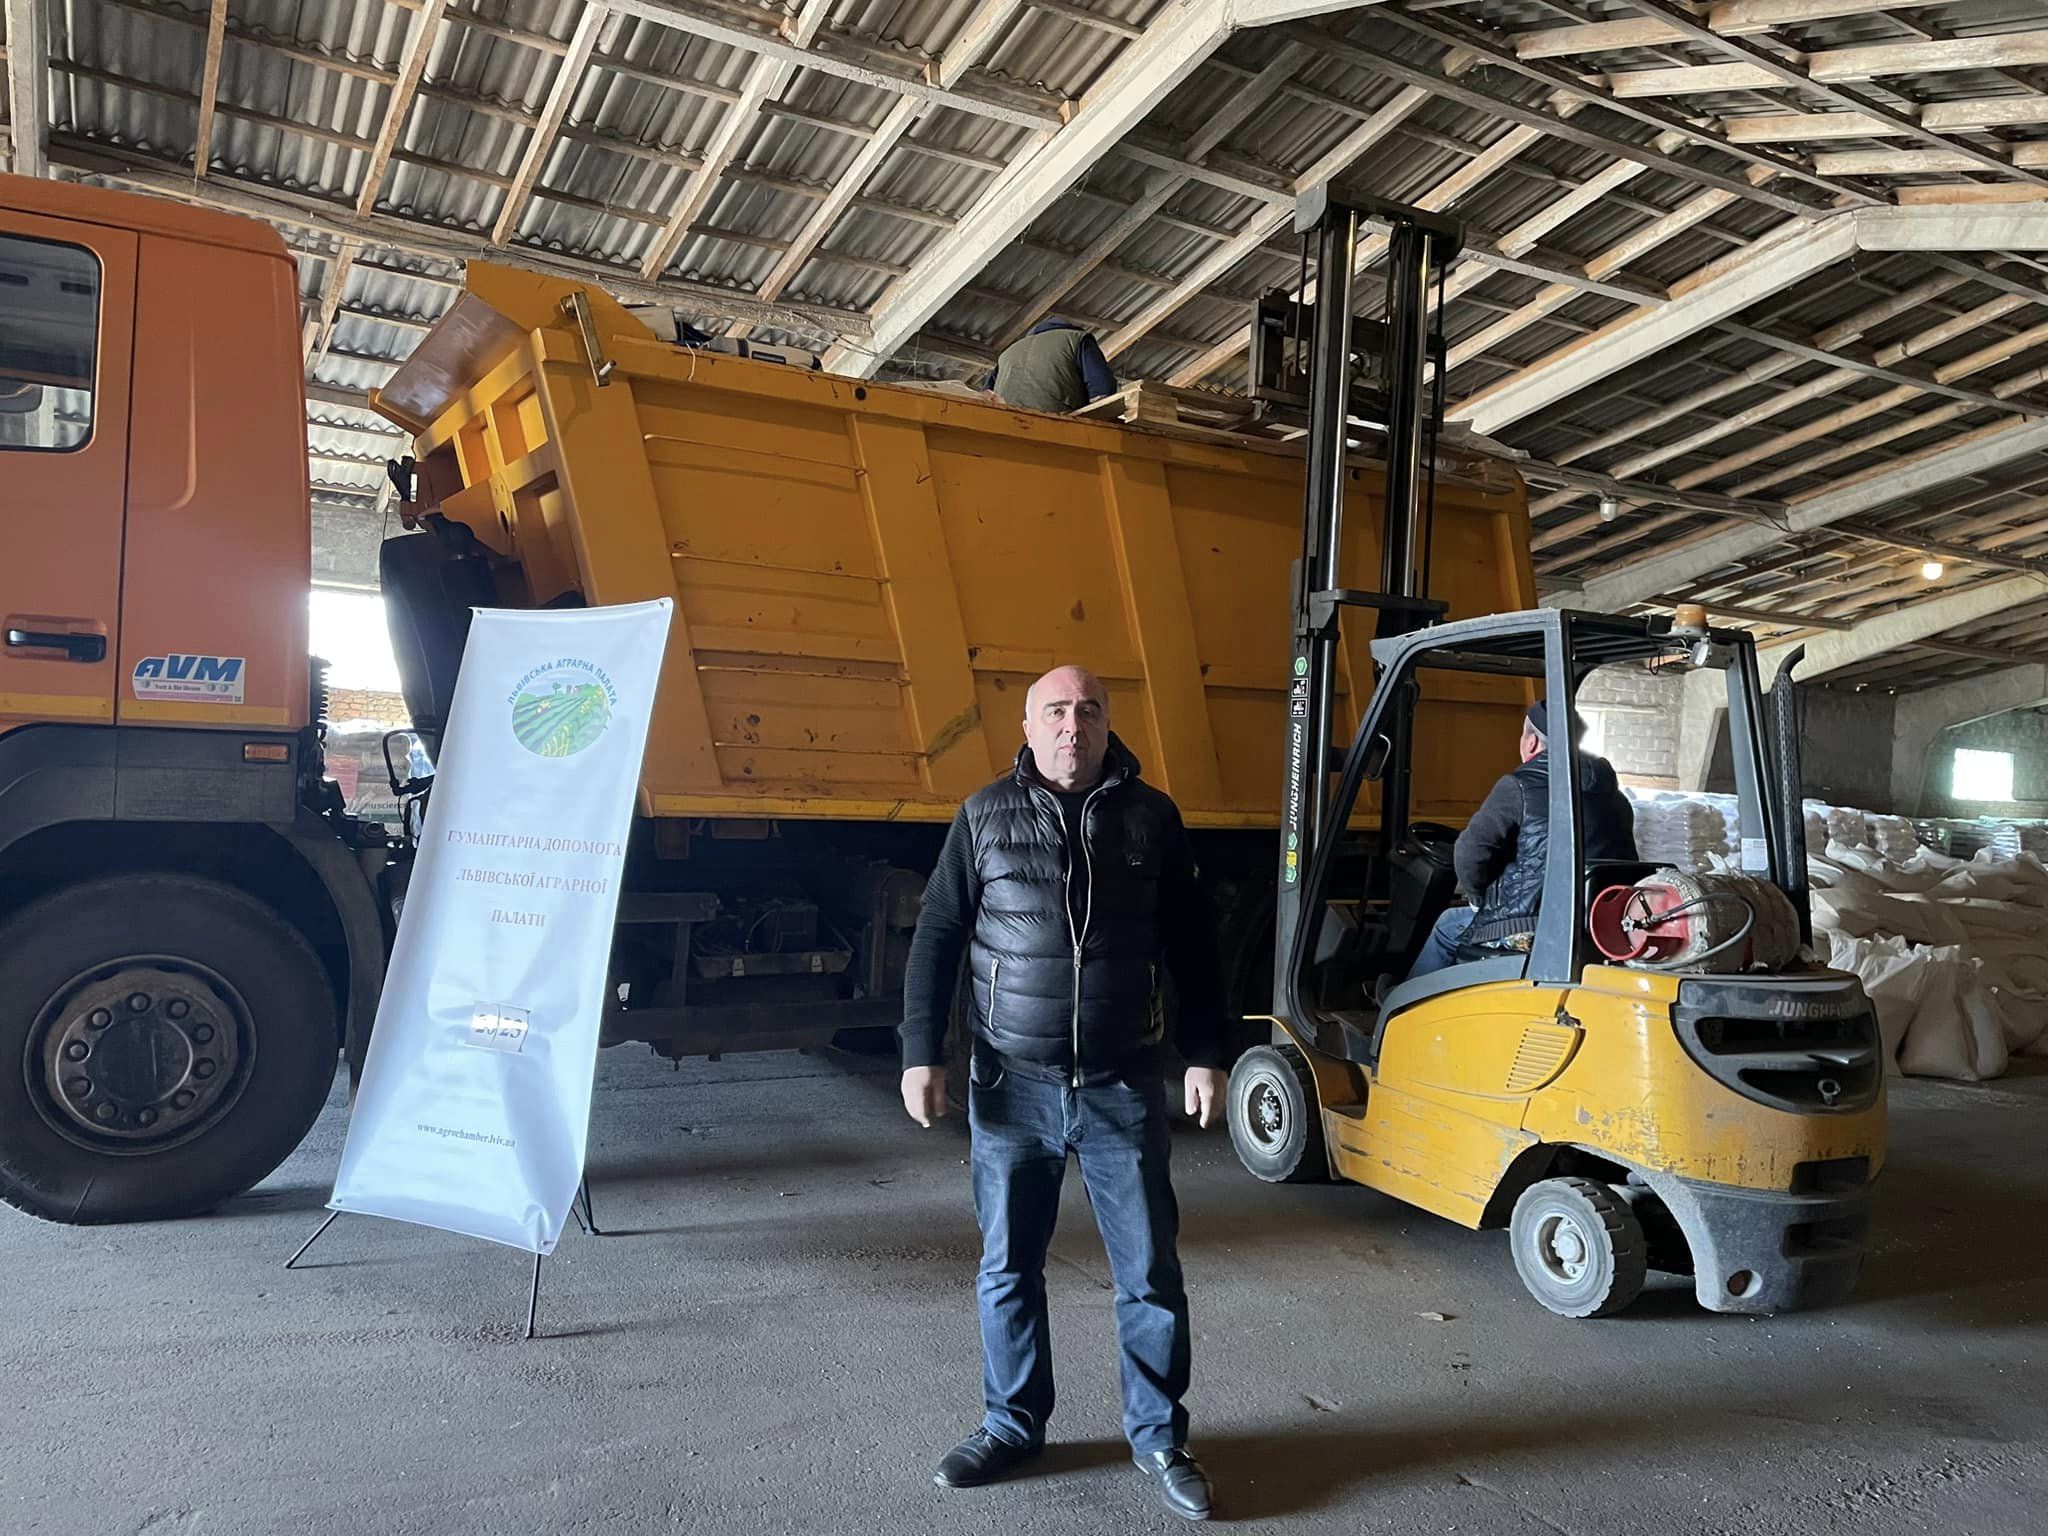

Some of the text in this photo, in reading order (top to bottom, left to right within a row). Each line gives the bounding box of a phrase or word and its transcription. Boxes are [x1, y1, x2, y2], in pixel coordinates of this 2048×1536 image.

[134, 655, 243, 682] AVM
[507, 658, 617, 706] ЛЬВІВСЬКА АГРАРНА ПАЛАТА
[1288, 723, 1302, 831] JUNGHEINRICH
[447, 830, 622, 856] ГУМАНІТАРНА ДОПОМОГА
[456, 868, 608, 894] ЛЬВІВСЬКОЇ АГРАРНОЇ
[491, 909, 546, 927] ПАЛАТИ
